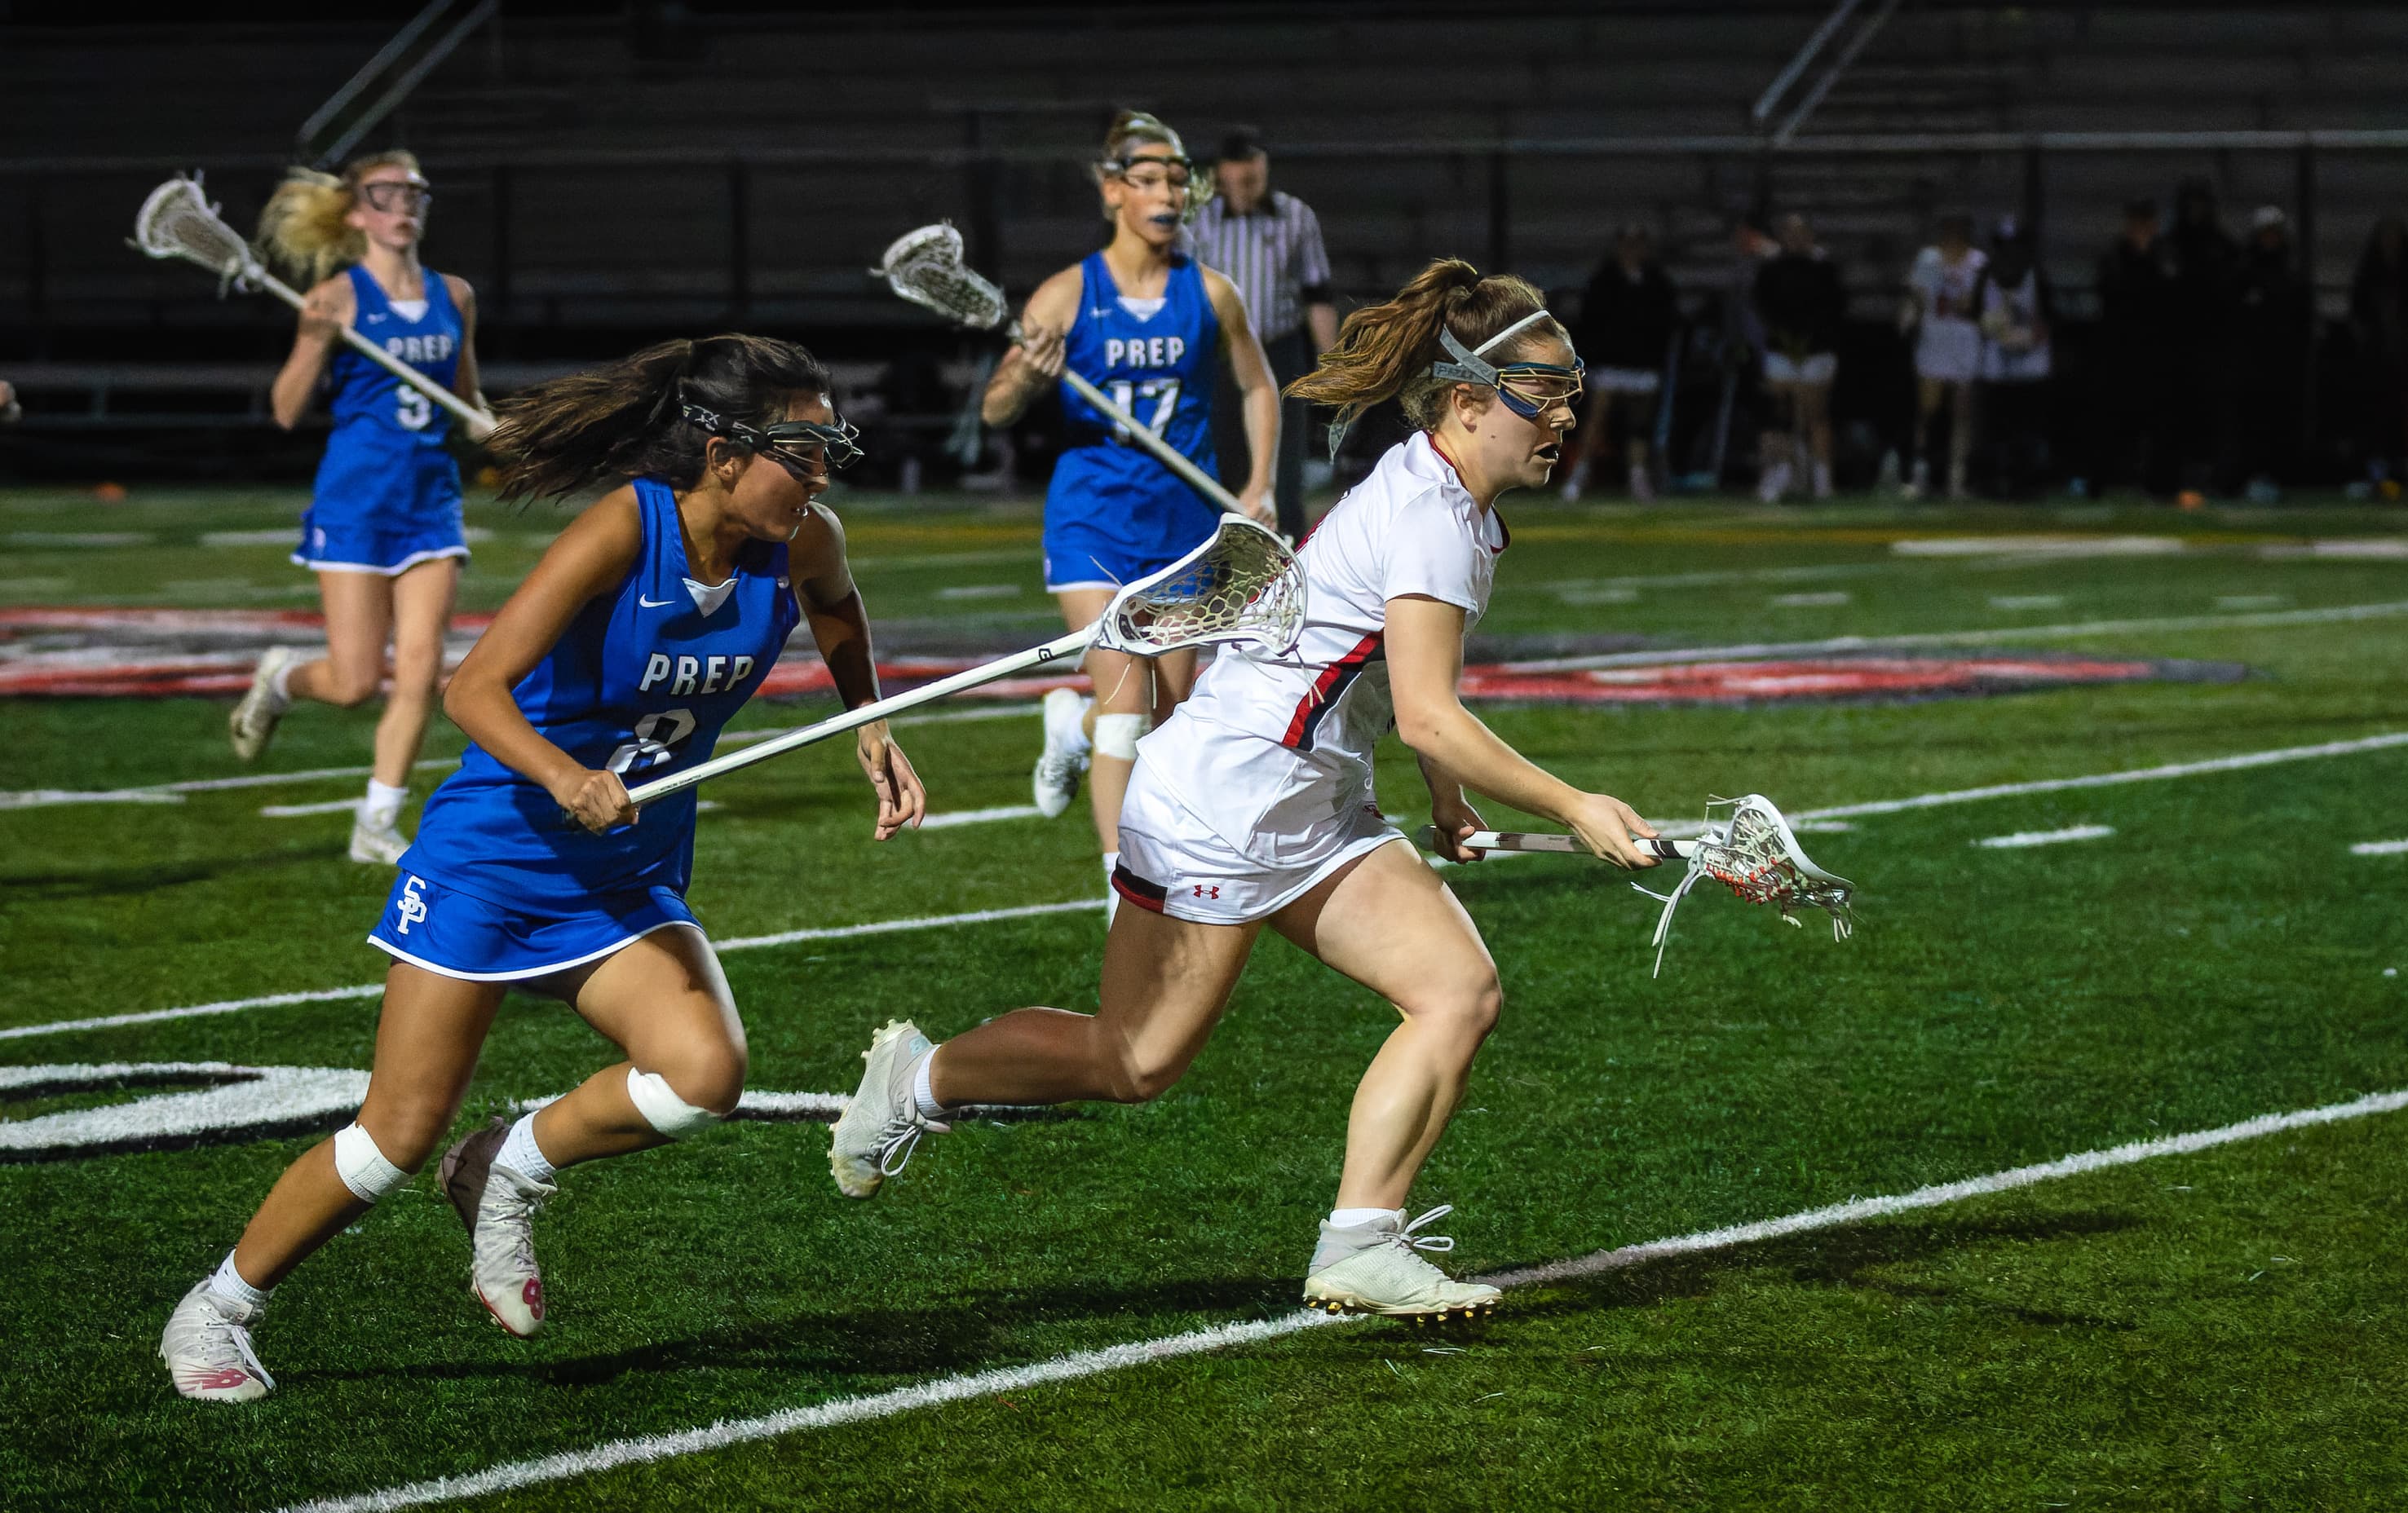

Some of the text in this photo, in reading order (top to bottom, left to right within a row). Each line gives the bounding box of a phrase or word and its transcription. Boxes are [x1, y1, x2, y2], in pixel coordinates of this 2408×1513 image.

[386, 334, 452, 362] PREP
[1106, 337, 1184, 368] PREP
[1107, 377, 1182, 445] 17
[638, 653, 755, 695] PREP
